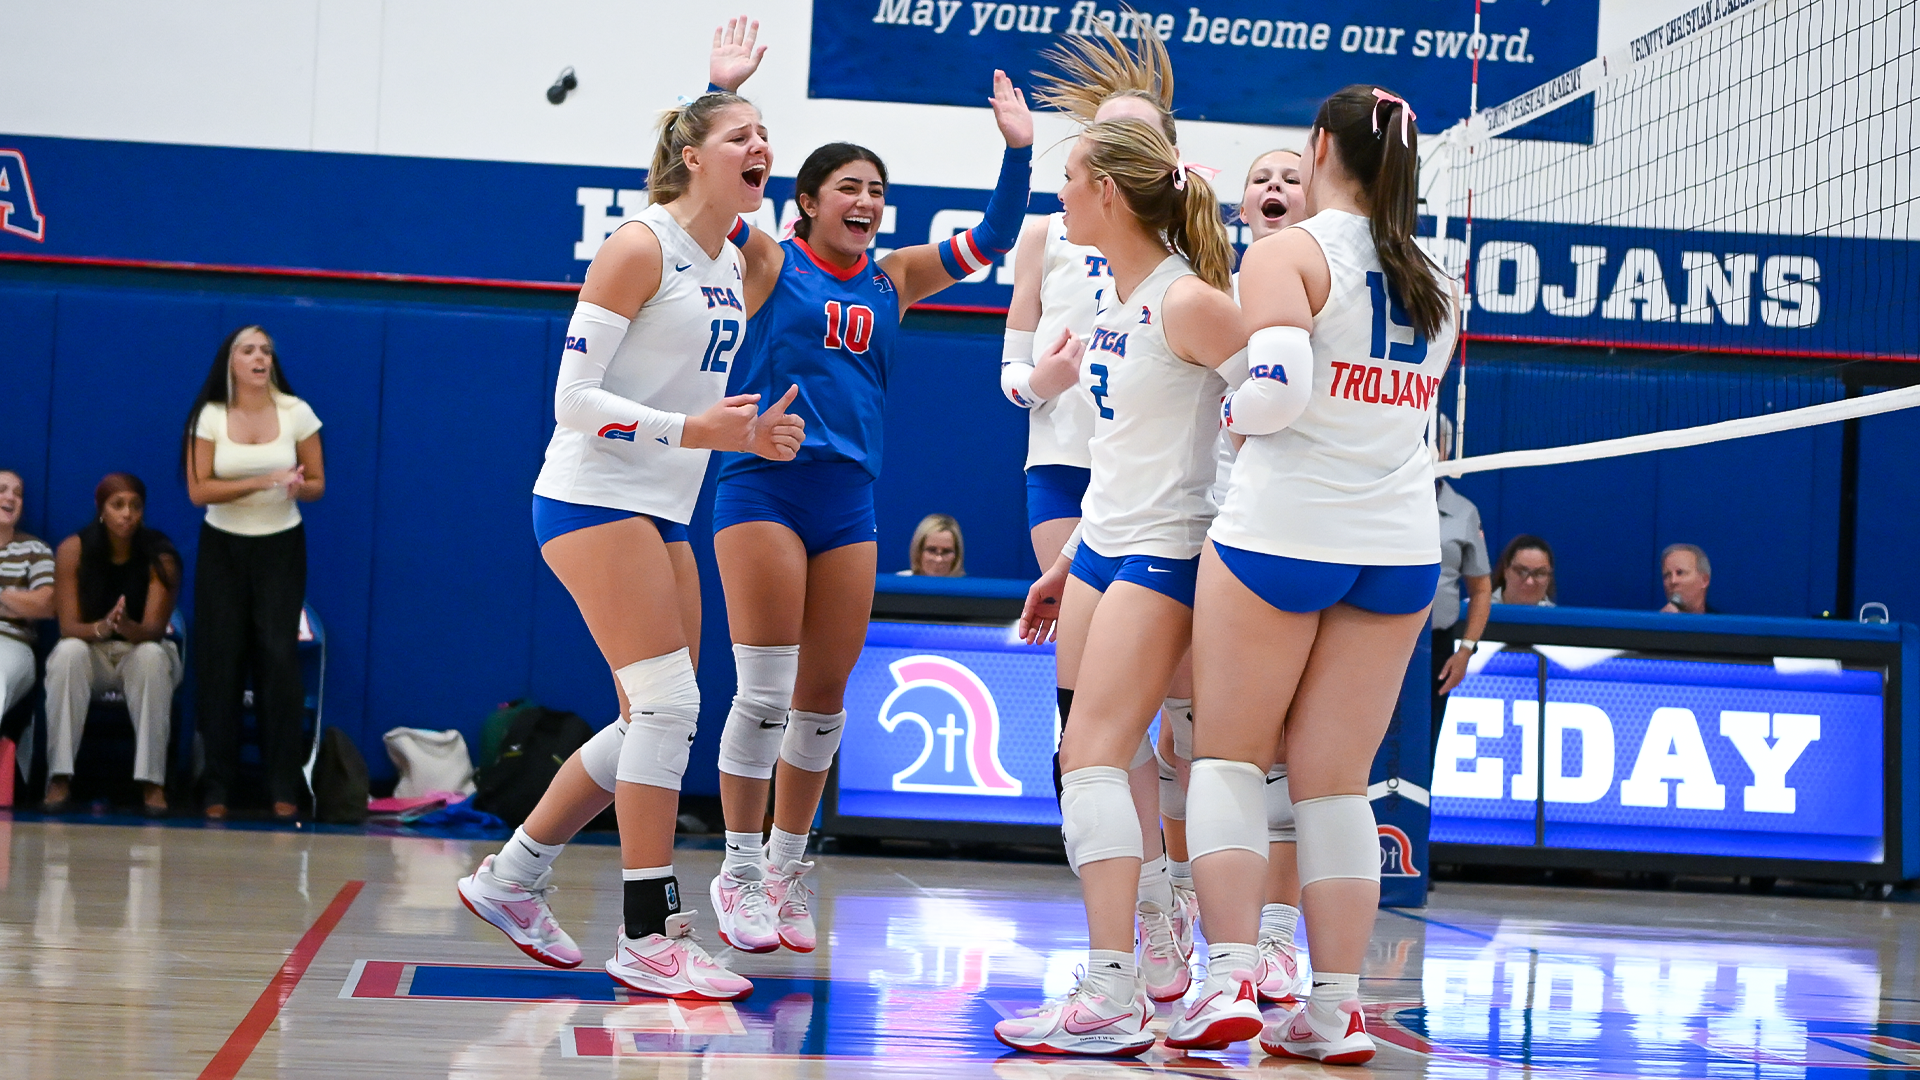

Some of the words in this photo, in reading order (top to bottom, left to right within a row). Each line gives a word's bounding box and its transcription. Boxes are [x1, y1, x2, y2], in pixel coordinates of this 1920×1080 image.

[873, 0, 962, 34] May
[969, 1, 1060, 36] your
[1066, 0, 1175, 41] flame
[1182, 7, 1331, 51] become
[1340, 24, 1405, 55] our
[1412, 27, 1534, 64] sword.
[1630, 26, 1664, 63] TRINITY
[1666, 0, 1712, 46] CHRISTIAN
[700, 285, 743, 312] TCA
[699, 318, 741, 374] 12
[823, 299, 875, 355] 10
[1089, 326, 1130, 360] TCA
[1089, 362, 1115, 421] 2
